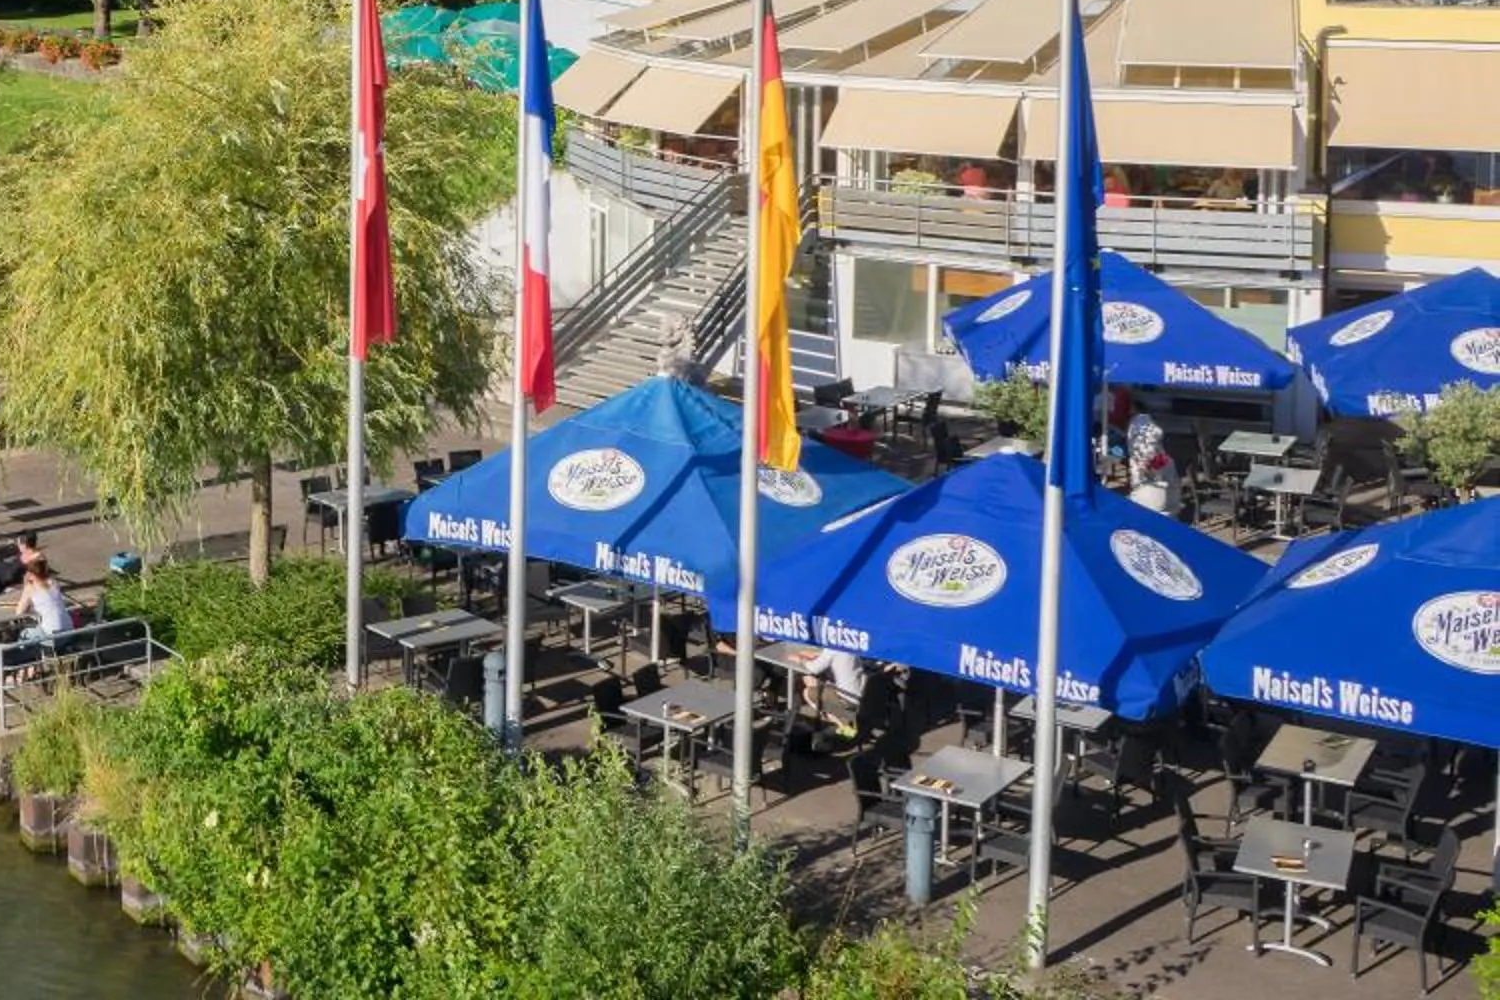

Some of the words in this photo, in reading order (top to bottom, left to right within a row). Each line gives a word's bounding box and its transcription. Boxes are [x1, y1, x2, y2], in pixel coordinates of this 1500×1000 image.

[1164, 361, 1213, 383] Maisel's
[1216, 364, 1260, 387] Weisse
[428, 511, 479, 542] Maisel's
[482, 519, 513, 547] Weis
[595, 541, 651, 579] Maisel's
[654, 555, 704, 593] Weisse
[812, 615, 869, 652] Weisse
[960, 643, 1031, 688] Maisel's
[1253, 666, 1332, 709] Maisel's
[1339, 680, 1413, 725] Weisse
